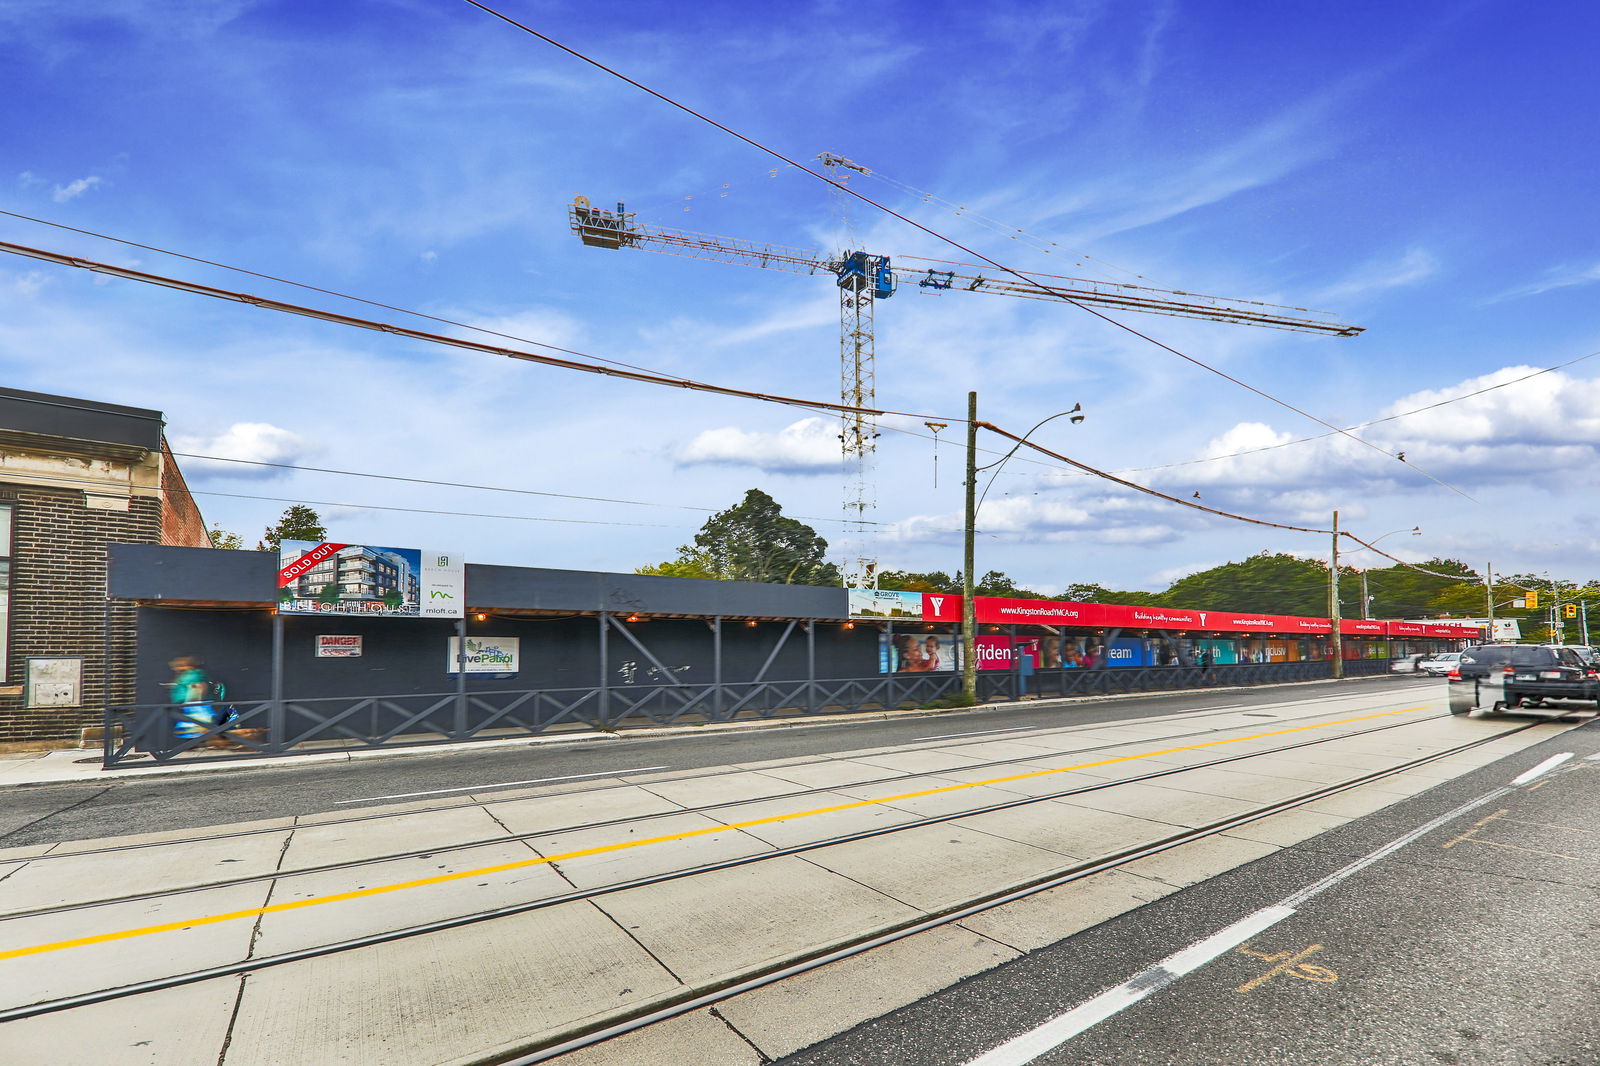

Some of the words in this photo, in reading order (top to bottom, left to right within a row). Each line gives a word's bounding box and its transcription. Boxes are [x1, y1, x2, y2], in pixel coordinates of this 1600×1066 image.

[283, 559, 312, 579] SOLD
[312, 544, 333, 560] OUT
[1001, 607, 1079, 618] www.KingstonRoadYMCA.org
[321, 637, 358, 645] DANGER
